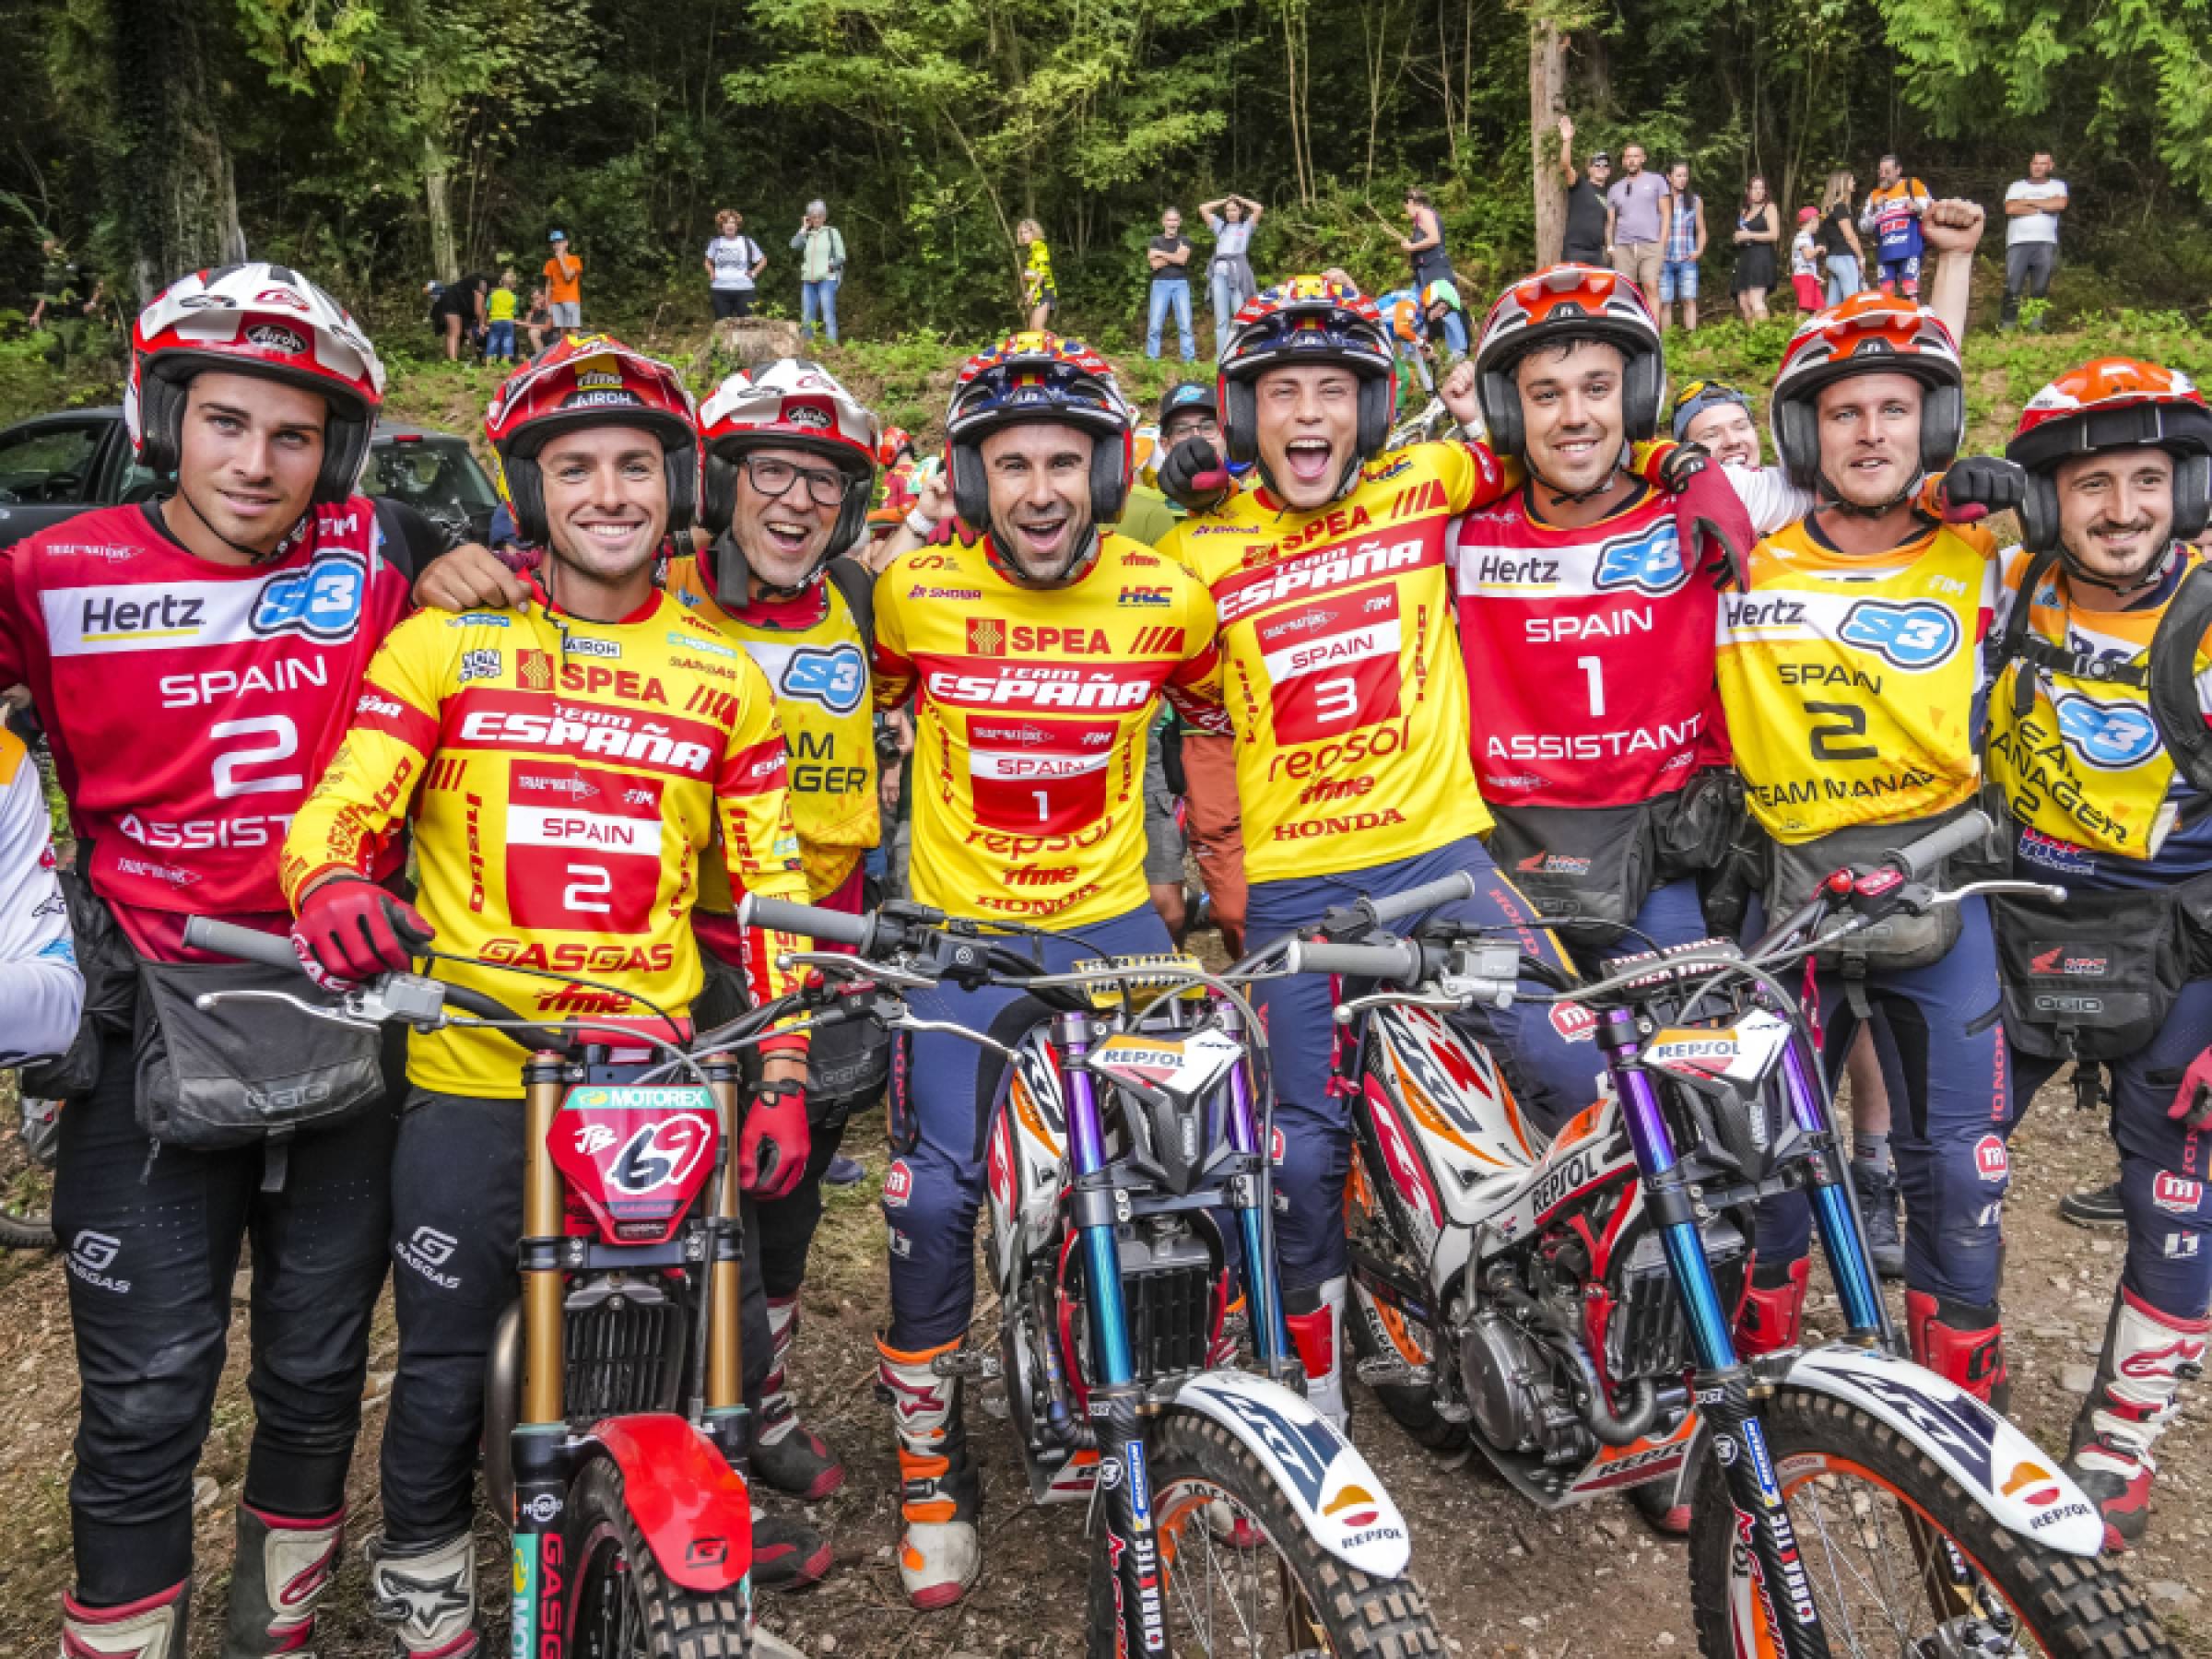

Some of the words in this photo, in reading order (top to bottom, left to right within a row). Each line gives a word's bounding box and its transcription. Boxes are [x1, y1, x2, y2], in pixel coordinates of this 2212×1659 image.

[1282, 505, 1372, 551] SPEA
[1277, 546, 1349, 576] TEAM
[1479, 555, 1560, 583] Hertz
[1218, 538, 1423, 621] ESPAÑA
[82, 595, 205, 633] Hertz
[1525, 606, 1653, 643] SPAIN
[1726, 599, 1806, 628] Hertz
[1011, 626, 1112, 655] SPEA
[1292, 634, 1374, 670] SPAIN
[160, 656, 327, 708] SPAIN
[560, 664, 668, 705] SPEA
[929, 671, 1151, 707] ESPAÑA
[999, 666, 1081, 680] TEAM
[1578, 656, 1606, 716] 1
[553, 702, 631, 728] TEAM
[1316, 677, 1358, 724] 3
[460, 712, 712, 772] ESPAÑA
[1268, 715, 1409, 782] repsol
[1488, 712, 1701, 759] ASSISTANT
[1803, 701, 1878, 760] 2
[210, 715, 302, 798] 2
[996, 759, 1085, 776] SPAIN
[1030, 791, 1050, 822] 1
[1272, 808, 1406, 841] HONDA
[120, 813, 295, 849] ASSIST
[543, 818, 634, 846] SPAIN
[563, 865, 611, 913] 2
[478, 937, 674, 973] GASGAS
[1103, 1049, 1187, 1067] REPSOL
[1657, 1041, 1742, 1059] REPSOL
[610, 1089, 705, 1108] MOTOREX
[1532, 1147, 1599, 1216] REPSOL
[1341, 1527, 1405, 1550] REPSOL
[540, 1532, 564, 1659] GASG
